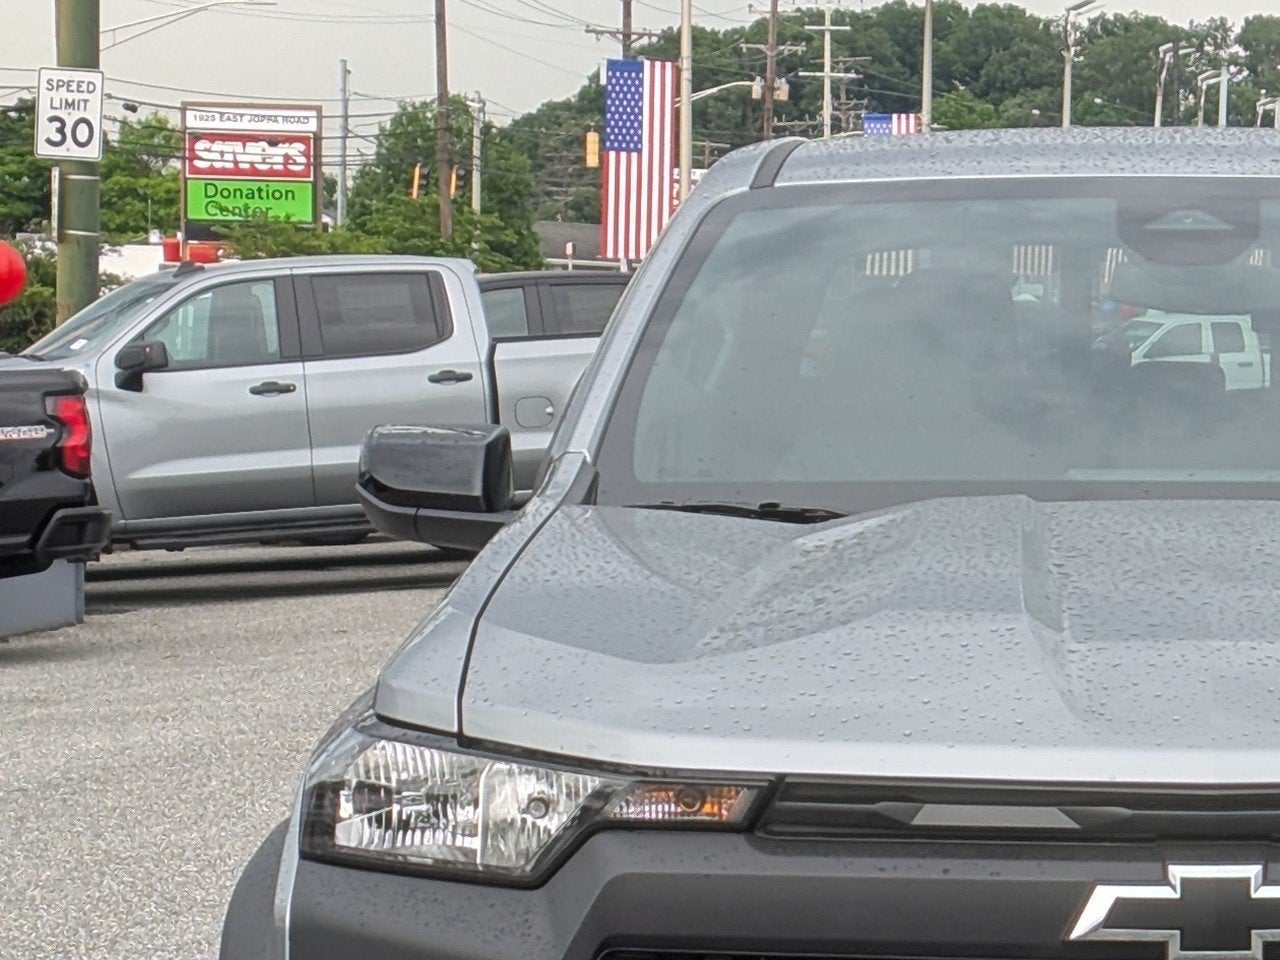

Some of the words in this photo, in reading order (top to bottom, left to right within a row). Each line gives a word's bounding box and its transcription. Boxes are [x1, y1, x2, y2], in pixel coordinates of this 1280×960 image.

[45, 78, 96, 94] SPEED
[49, 97, 90, 111] LIMIT
[247, 116, 280, 124] JOPPA
[282, 117, 310, 125] ROAD
[44, 115, 94, 148] 30
[204, 183, 296, 201] Donation
